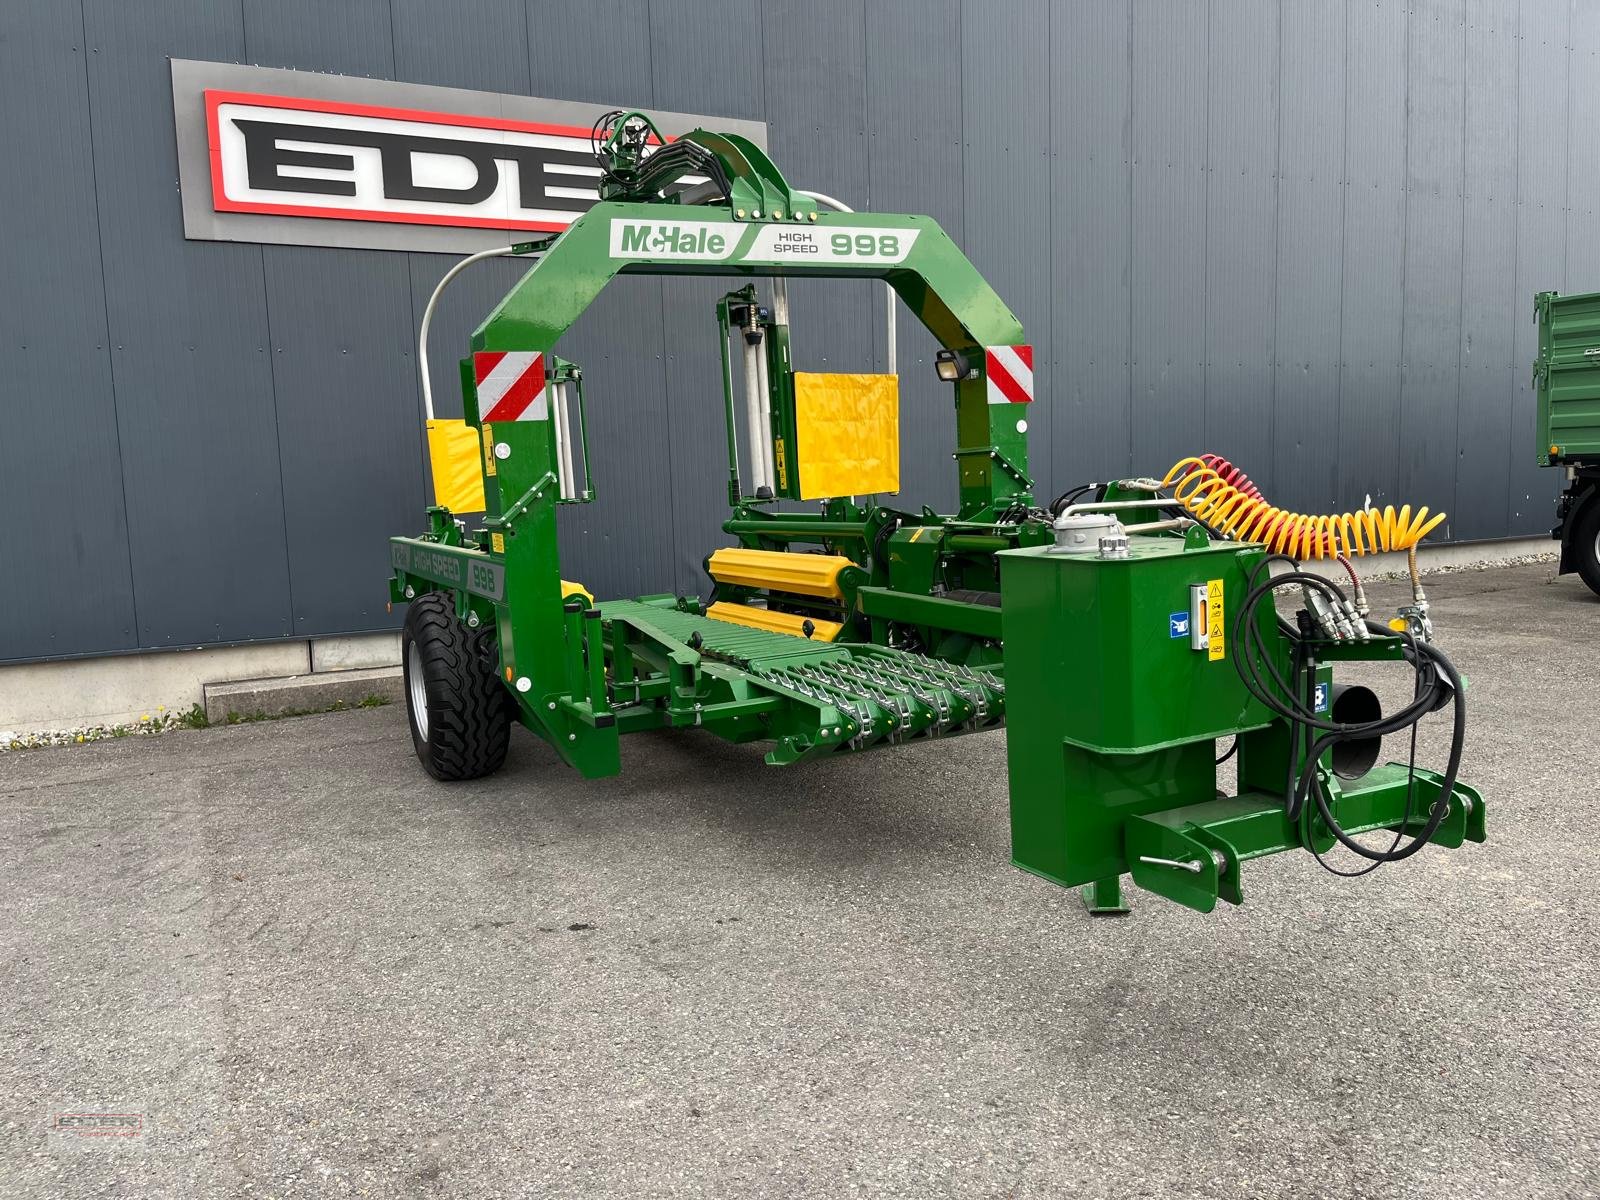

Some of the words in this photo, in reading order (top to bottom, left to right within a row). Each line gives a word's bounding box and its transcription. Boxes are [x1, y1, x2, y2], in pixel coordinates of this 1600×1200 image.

[231, 118, 705, 214] EDE
[621, 225, 726, 255] McHale
[773, 243, 819, 254] SPEED
[778, 233, 813, 243] HIGH
[830, 234, 900, 257] 998
[413, 550, 432, 573] HIGH
[432, 553, 461, 582] SPEED
[473, 564, 496, 593] 998
